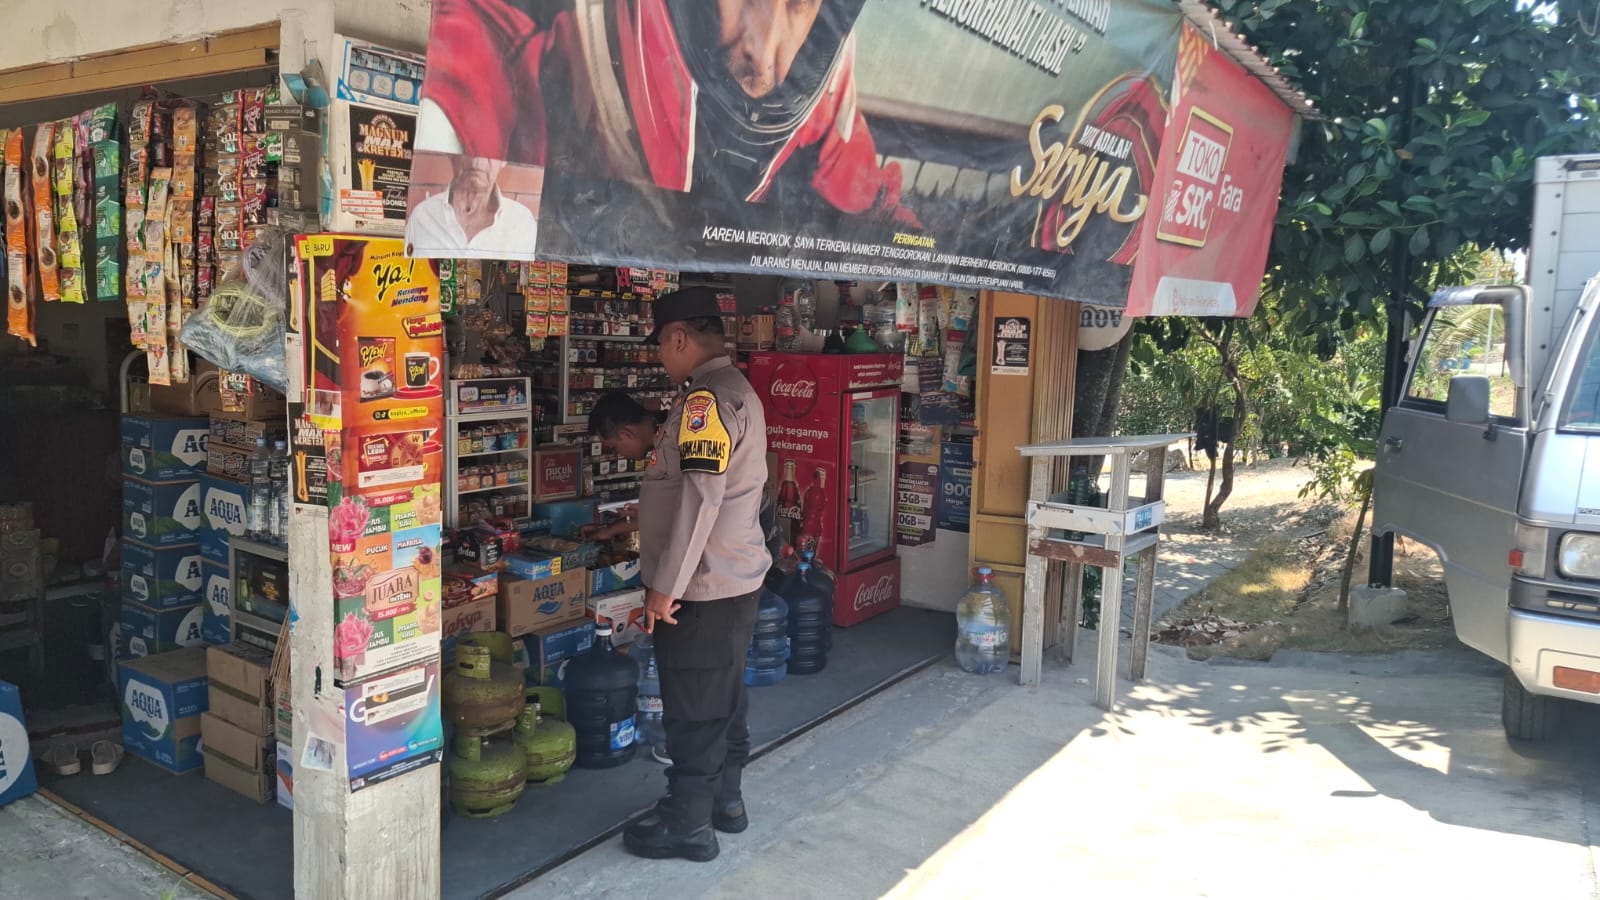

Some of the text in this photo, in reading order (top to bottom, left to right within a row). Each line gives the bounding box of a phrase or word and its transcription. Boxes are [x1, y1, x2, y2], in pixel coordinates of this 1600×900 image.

[359, 123, 408, 143] MAGNUM
[364, 136, 404, 149] MAX
[1093, 131, 1133, 160] ADALAH
[1187, 136, 1221, 181] TOKO
[1217, 173, 1243, 212] Fara
[1176, 183, 1213, 229] SRC
[313, 243, 331, 251] BARU
[702, 225, 745, 243] KARENA
[793, 235, 815, 250] SAYA
[816, 238, 850, 253] TERKENA
[850, 242, 880, 257] KANKER
[932, 254, 961, 266] LAYANAN
[960, 256, 988, 269] BERHENTI
[987, 260, 1017, 273] MEROKOK
[893, 232, 936, 248] PERINGATAN:
[750, 255, 790, 269] DILARANG
[790, 259, 823, 272] MENJUAL
[823, 261, 839, 273] DAN
[838, 262, 868, 275] MEMBERI
[868, 264, 892, 277] KEPADA
[892, 267, 914, 278] ORANG
[948, 272, 965, 284] TAHUN
[965, 275, 977, 284] DAN
[391, 295, 429, 307] Nendang
[1080, 308, 1122, 328] AQU
[771, 378, 815, 398] Coca-Cola
[786, 427, 829, 439] segarnya
[771, 439, 814, 453] sekarang
[210, 498, 242, 524] AQUA
[365, 525, 387, 535] JAMBU
[332, 543, 352, 552] NEW
[366, 544, 388, 554] PUCUK
[212, 584, 230, 608] AQ
[371, 574, 412, 604] JUARA
[533, 581, 565, 602] AQUA
[853, 573, 894, 611] Coca-Cola
[369, 637, 390, 648] JAMBU
[131, 688, 163, 720] AQUA
